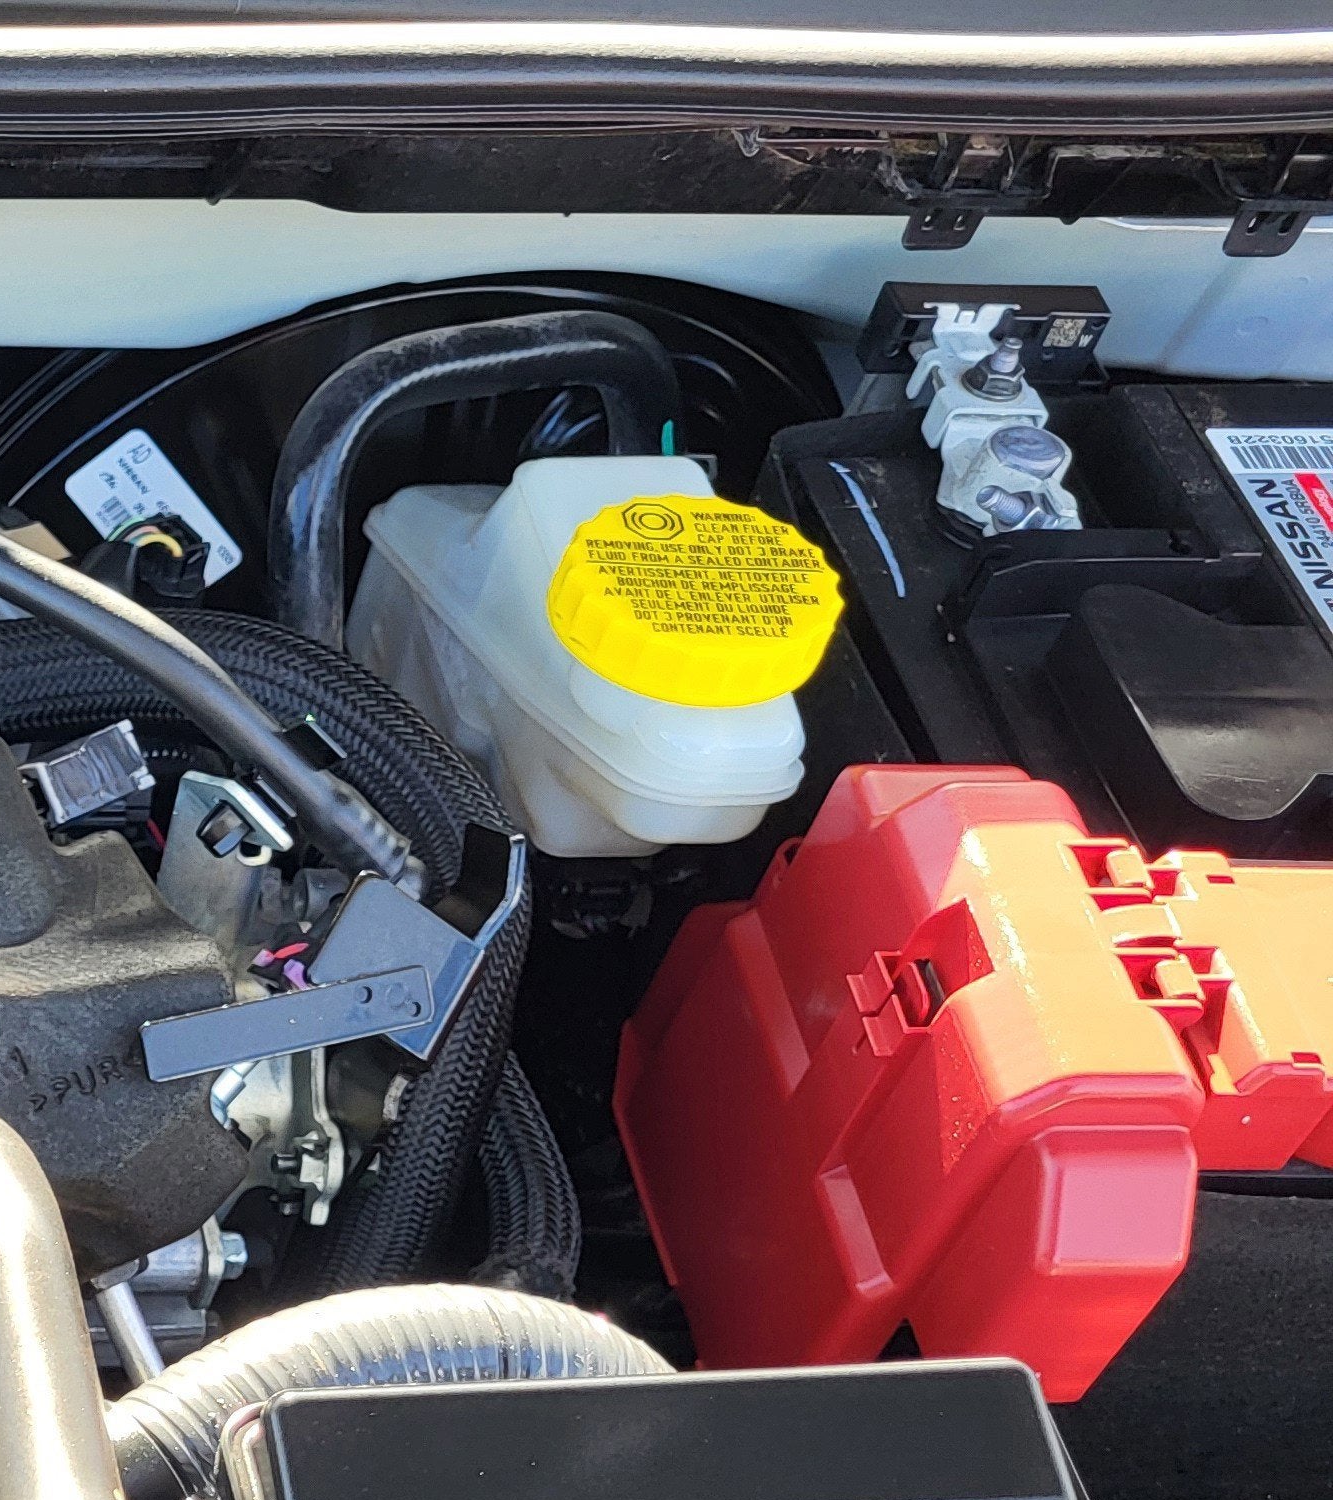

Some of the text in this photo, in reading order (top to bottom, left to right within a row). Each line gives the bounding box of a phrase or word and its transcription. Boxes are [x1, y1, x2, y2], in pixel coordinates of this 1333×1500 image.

[690, 511, 756, 523] WARNING:
[693, 522, 790, 536] CLEAN FILLER
[1247, 478, 1333, 590] NISSAN
[697, 534, 782, 546] CAP BEFORE
[588, 550, 628, 561] FLUID
[632, 551, 670, 564] FROM
[674, 554, 684, 564] A
[687, 555, 742, 568] SEALED
[660, 544, 687, 554] USE
[688, 544, 723, 555] ONLY
[727, 545, 754, 556] DOT
[770, 547, 816, 559] BRAKE
[617, 576, 797, 594] BOUCHON DE REMPLISSAGE
[719, 571, 792, 583] NETTOYER
[793, 573, 810, 584] LE
[603, 587, 651, 599] AVANT
[656, 589, 674, 600] DE
[758, 593, 820, 605] UTILISER
[630, 598, 790, 616] SEULEMENT DU LIQUIDE
[634, 609, 659, 621] DOT
[675, 611, 757, 625] PROVENANT
[652, 621, 733, 636] CONTENANT
